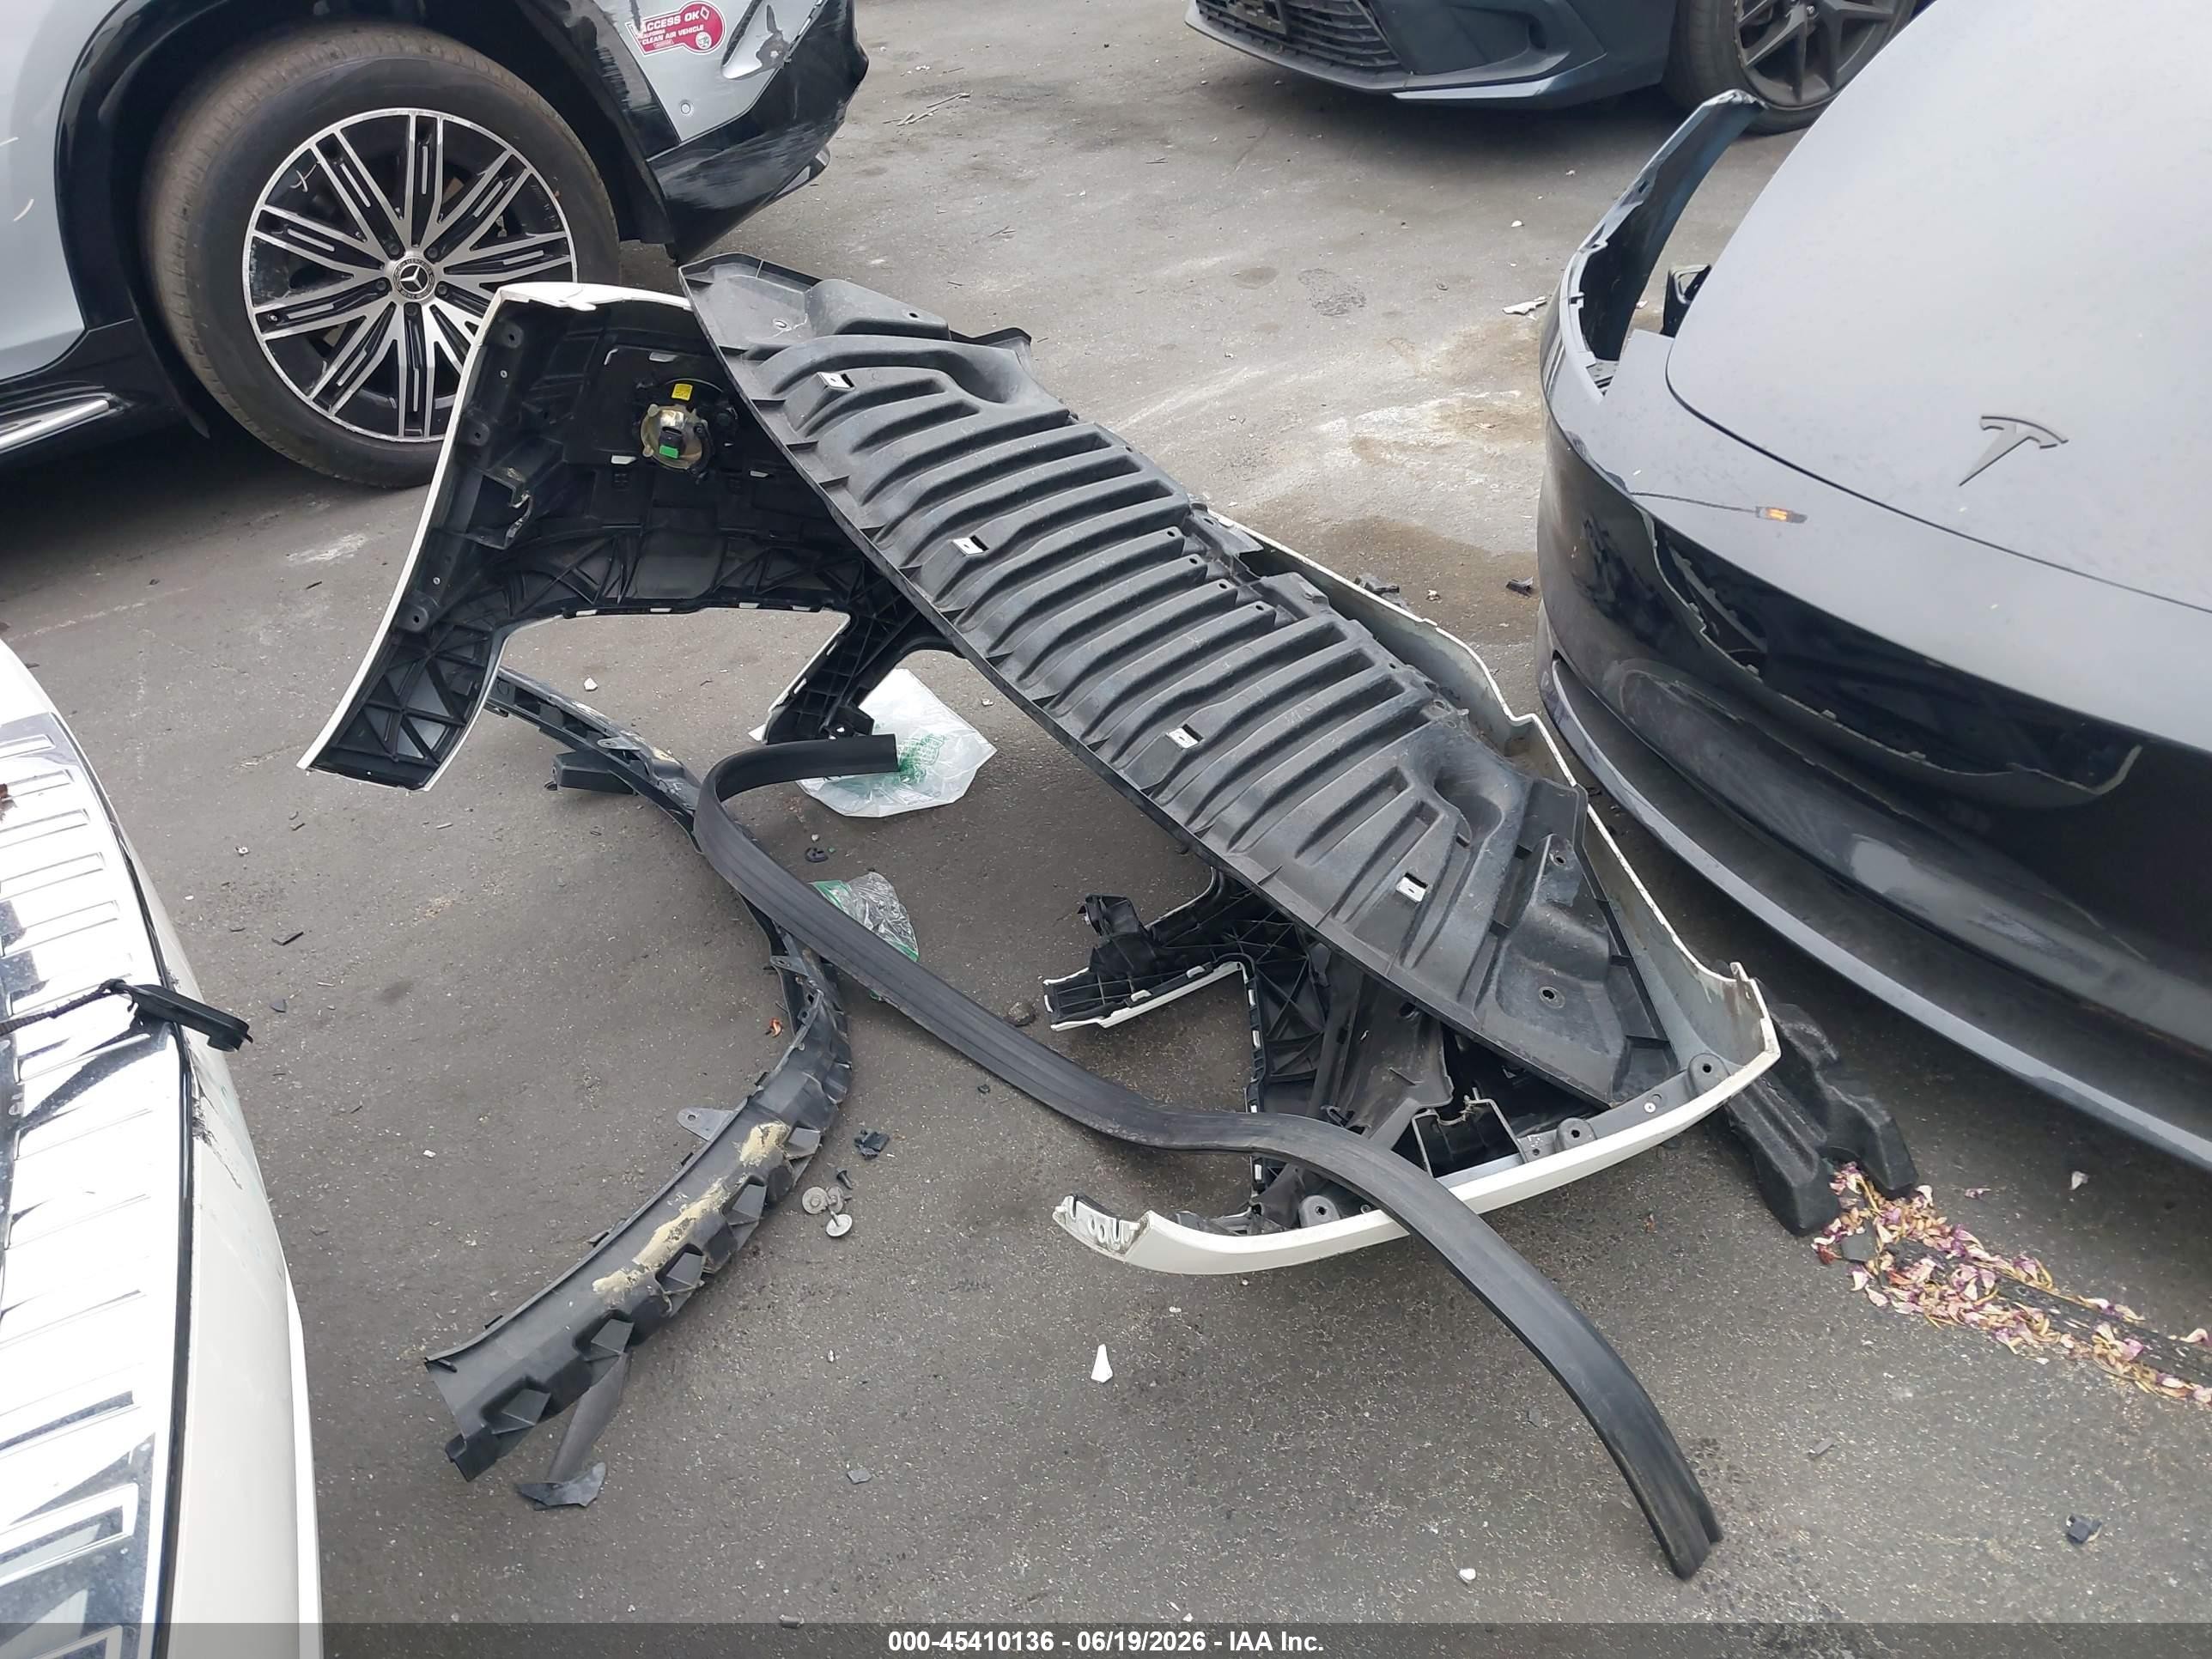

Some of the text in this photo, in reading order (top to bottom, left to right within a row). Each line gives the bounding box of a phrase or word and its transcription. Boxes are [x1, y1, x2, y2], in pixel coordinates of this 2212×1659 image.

[684, 10, 700, 22] OK
[641, 35, 664, 46] CLEAN
[665, 31, 677, 40] AIR
[678, 24, 704, 36] VEHICLE
